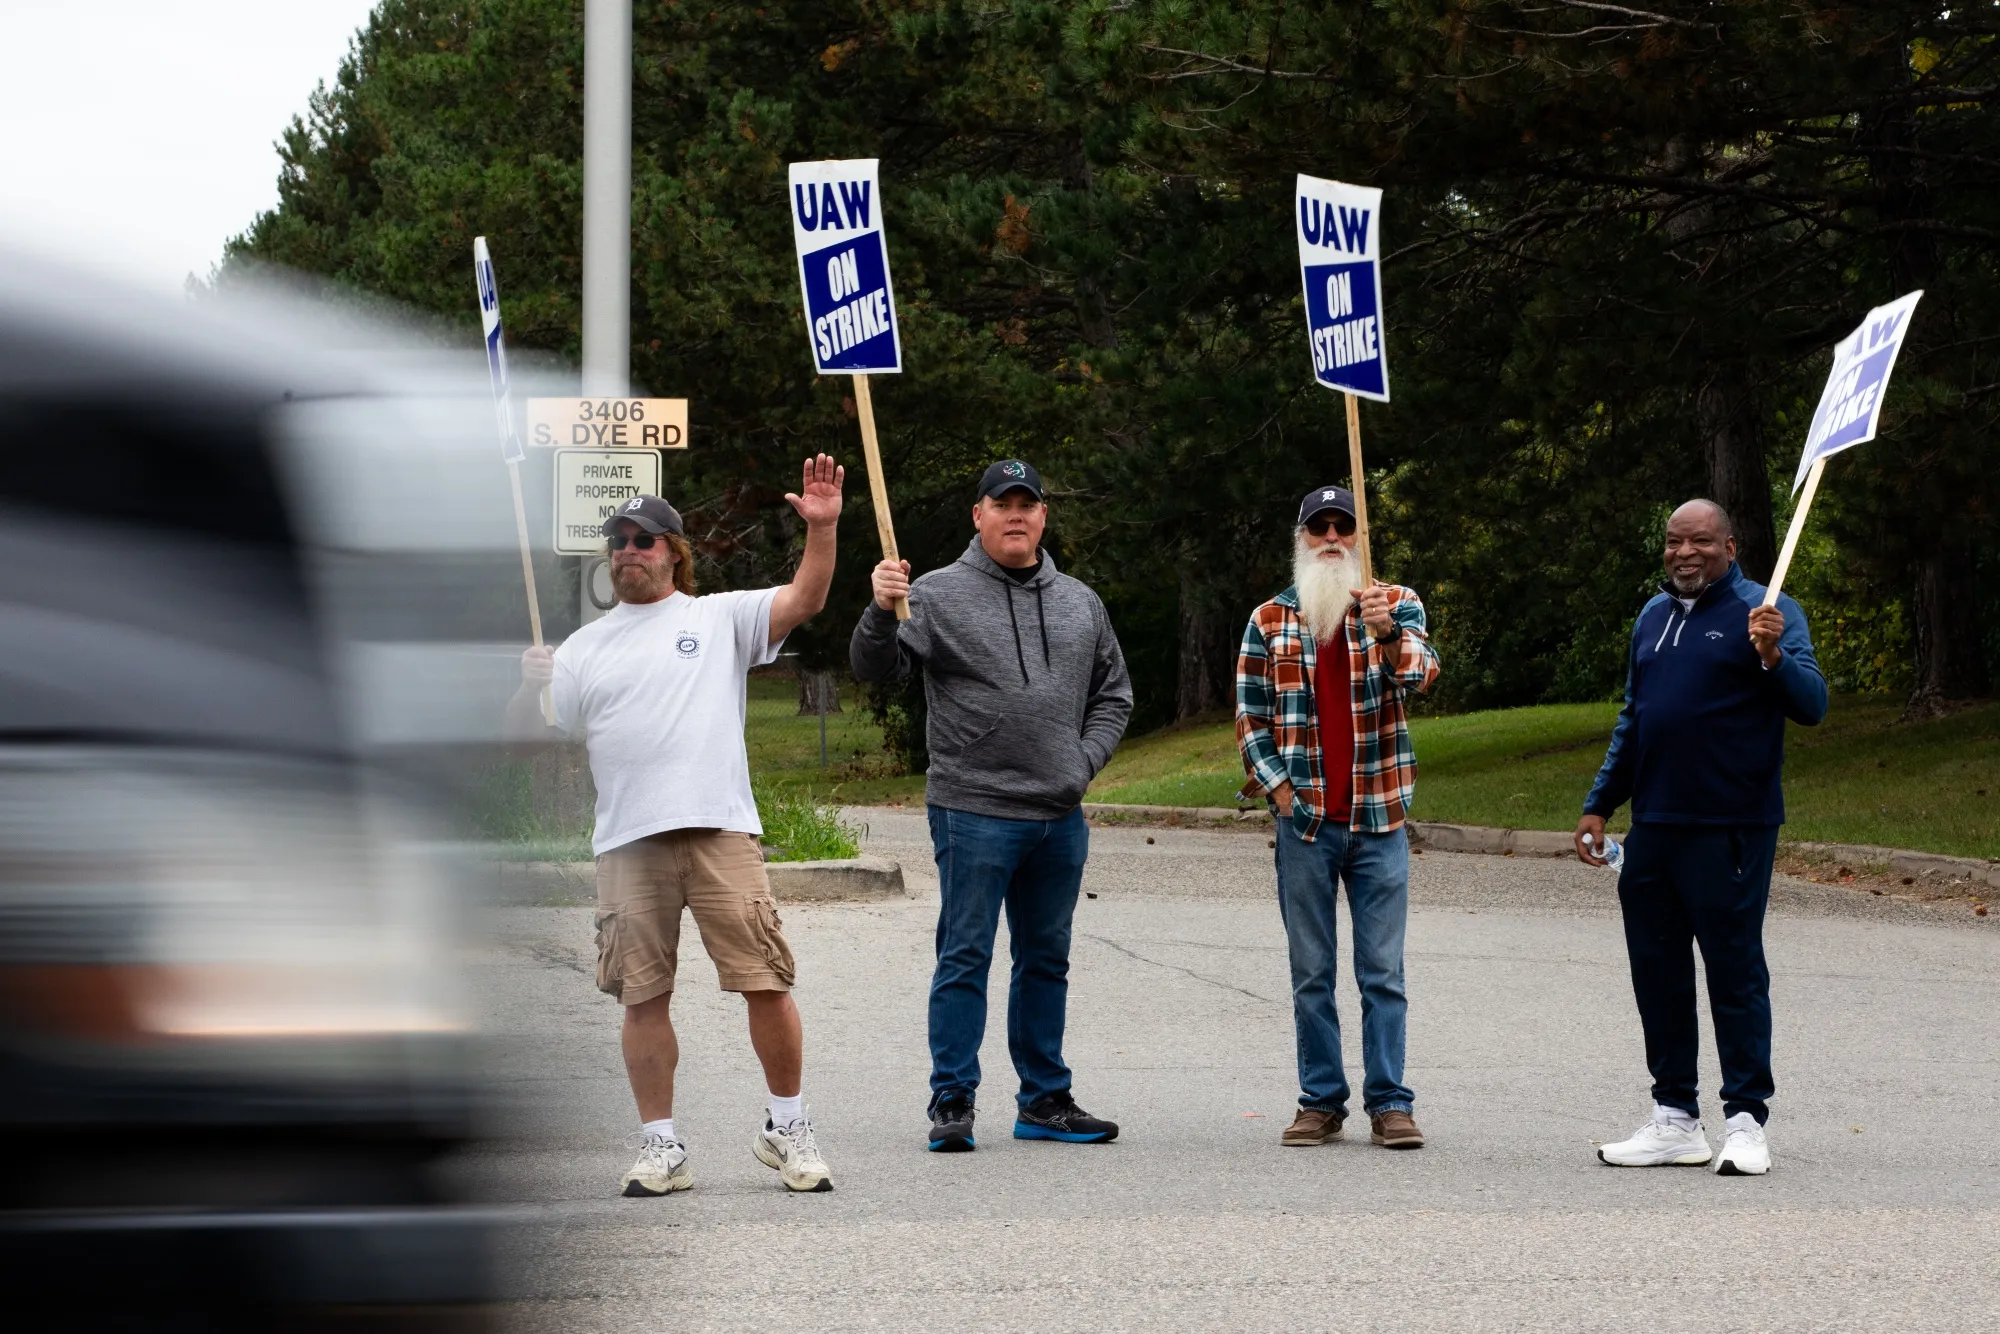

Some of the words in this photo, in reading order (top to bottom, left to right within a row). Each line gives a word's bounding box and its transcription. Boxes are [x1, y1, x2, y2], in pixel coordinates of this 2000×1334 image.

[795, 179, 871, 232] UAW
[1300, 195, 1371, 256] UAW
[477, 260, 498, 312] UA
[827, 248, 860, 302] ON
[1326, 271, 1353, 320] ON
[815, 287, 890, 361] STRIKE
[1313, 314, 1378, 372] STRIKE
[1846, 308, 1907, 360] AW
[534, 423, 559, 445] S.
[572, 423, 628, 446] DYE
[642, 424, 681, 446] RD
[578, 400, 645, 422] 3406
[575, 484, 640, 498] PROPERTY
[583, 465, 633, 479] PRIVATE
[565, 524, 604, 538] TRESP
[598, 505, 616, 518] NO
